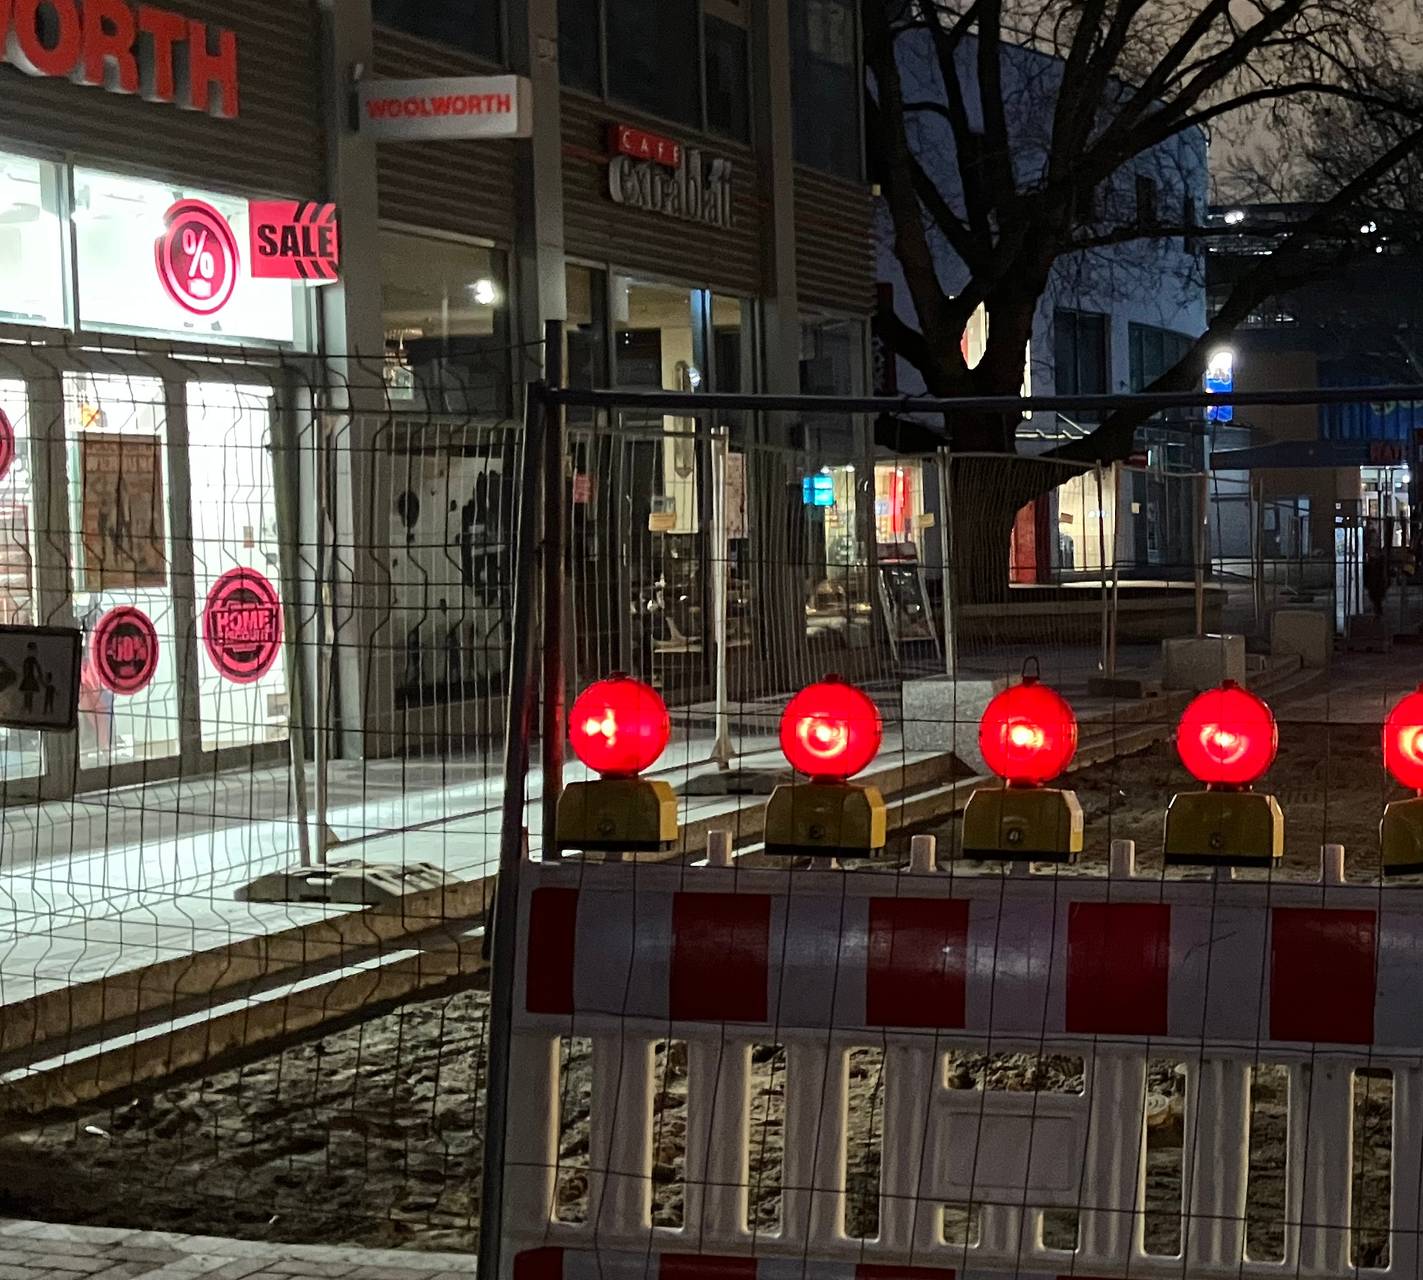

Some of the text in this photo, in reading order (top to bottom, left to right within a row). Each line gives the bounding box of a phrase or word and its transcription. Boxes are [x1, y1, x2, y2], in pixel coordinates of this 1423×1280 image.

[0, 0, 239, 119] ORTH
[366, 93, 511, 119] WOOLWORTH
[257, 223, 334, 258] SALE
[216, 610, 270, 631] HOME
